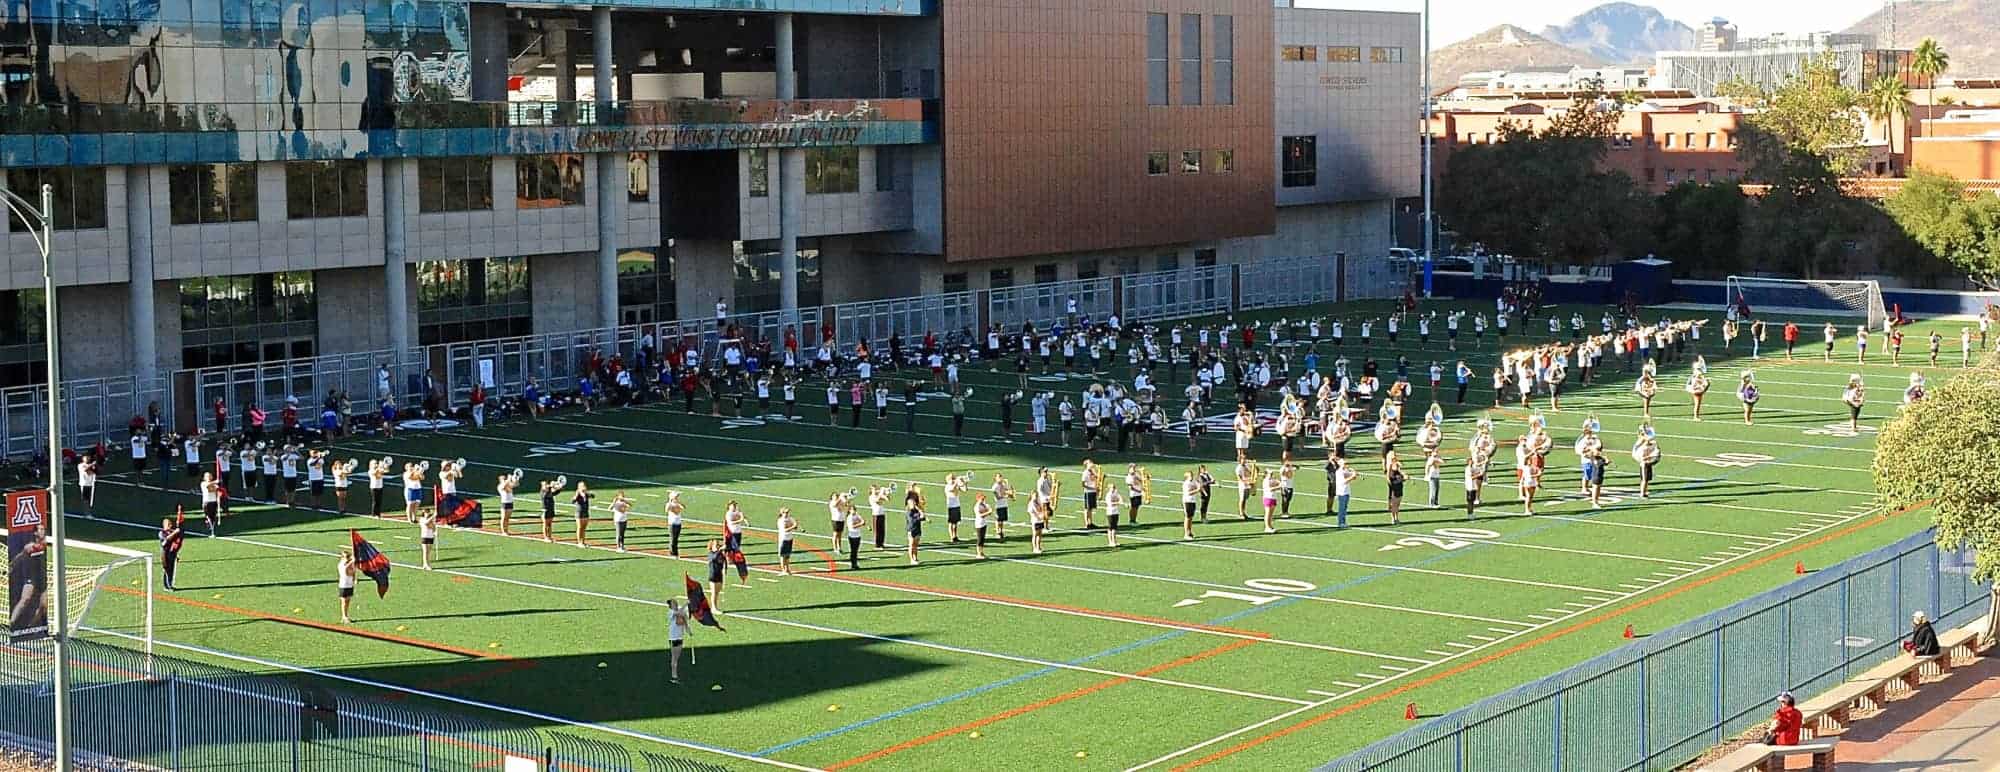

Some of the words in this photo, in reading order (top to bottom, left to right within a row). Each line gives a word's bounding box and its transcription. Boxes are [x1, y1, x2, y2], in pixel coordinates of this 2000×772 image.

[718, 127, 796, 145] FOOTBALL
[1695, 452, 1775, 467] 40
[12, 496, 42, 527] A
[1395, 528, 1500, 550] 20
[1200, 578, 1317, 605] 10
